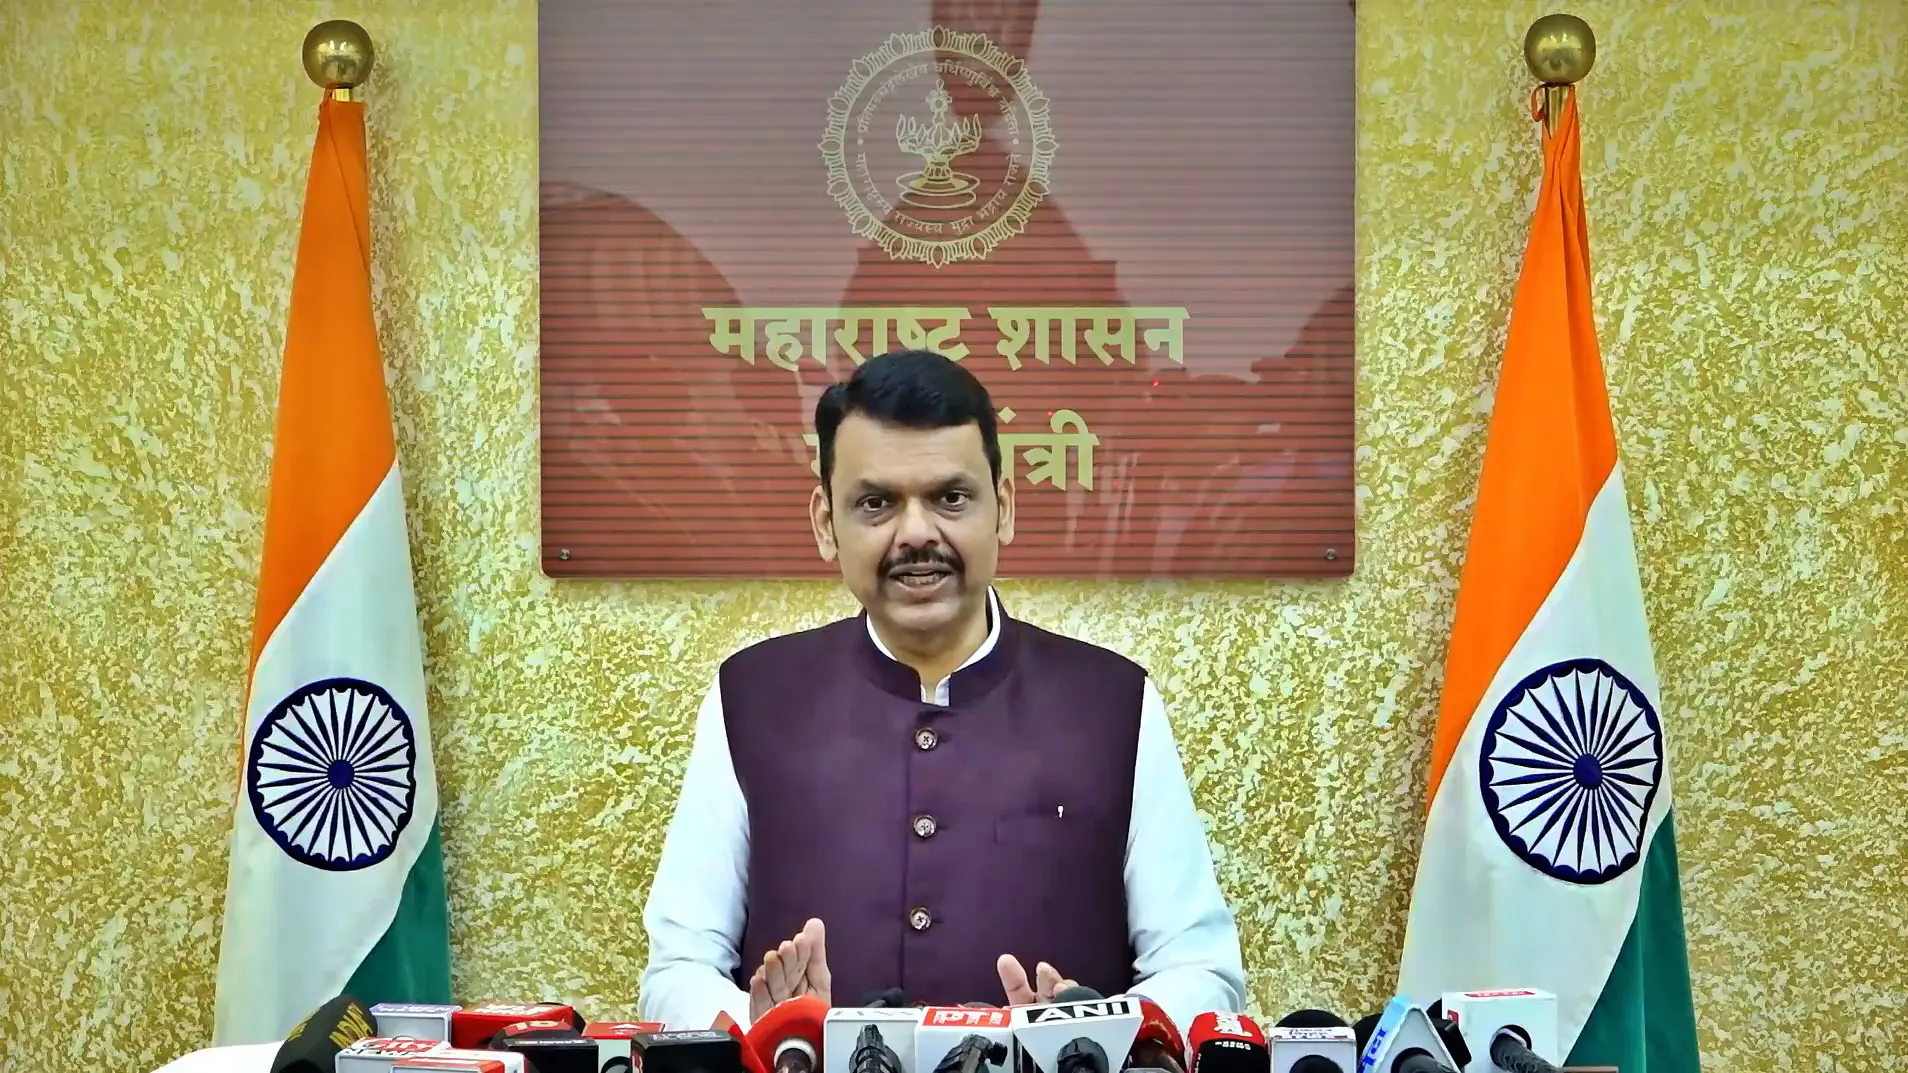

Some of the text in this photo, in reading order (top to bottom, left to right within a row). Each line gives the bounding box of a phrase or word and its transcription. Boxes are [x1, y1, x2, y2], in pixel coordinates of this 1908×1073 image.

[987, 307, 1190, 372] शासन
[932, 1010, 1004, 1026] PTI
[1034, 1001, 1124, 1022] ANI
